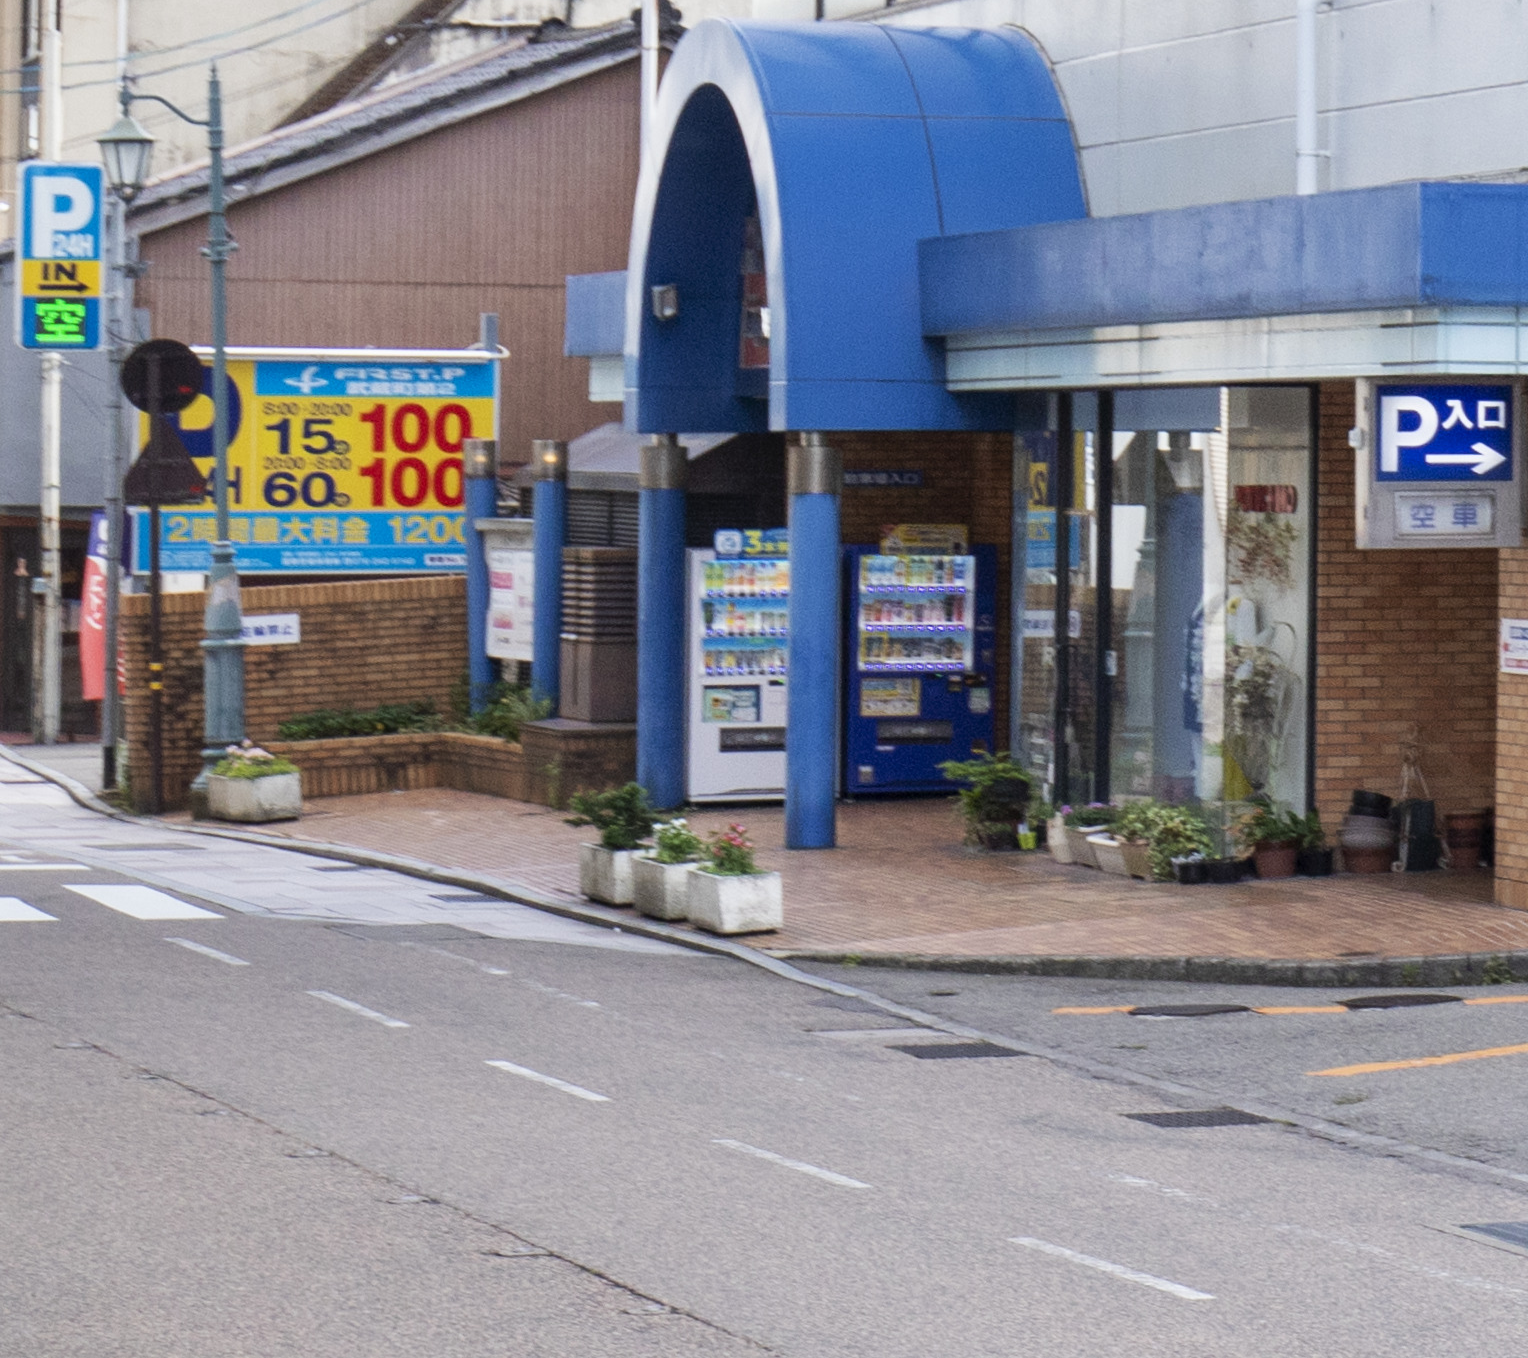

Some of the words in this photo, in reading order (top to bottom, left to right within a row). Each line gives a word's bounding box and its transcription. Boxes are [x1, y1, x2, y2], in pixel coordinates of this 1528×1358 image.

[32, 176, 94, 259] P
[42, 262, 76, 281] IN
[35, 298, 86, 343] 空
[359, 403, 474, 454] 100
[1381, 395, 1439, 473] P
[1441, 399, 1506, 430] 入口
[1410, 501, 1478, 529] 空車
